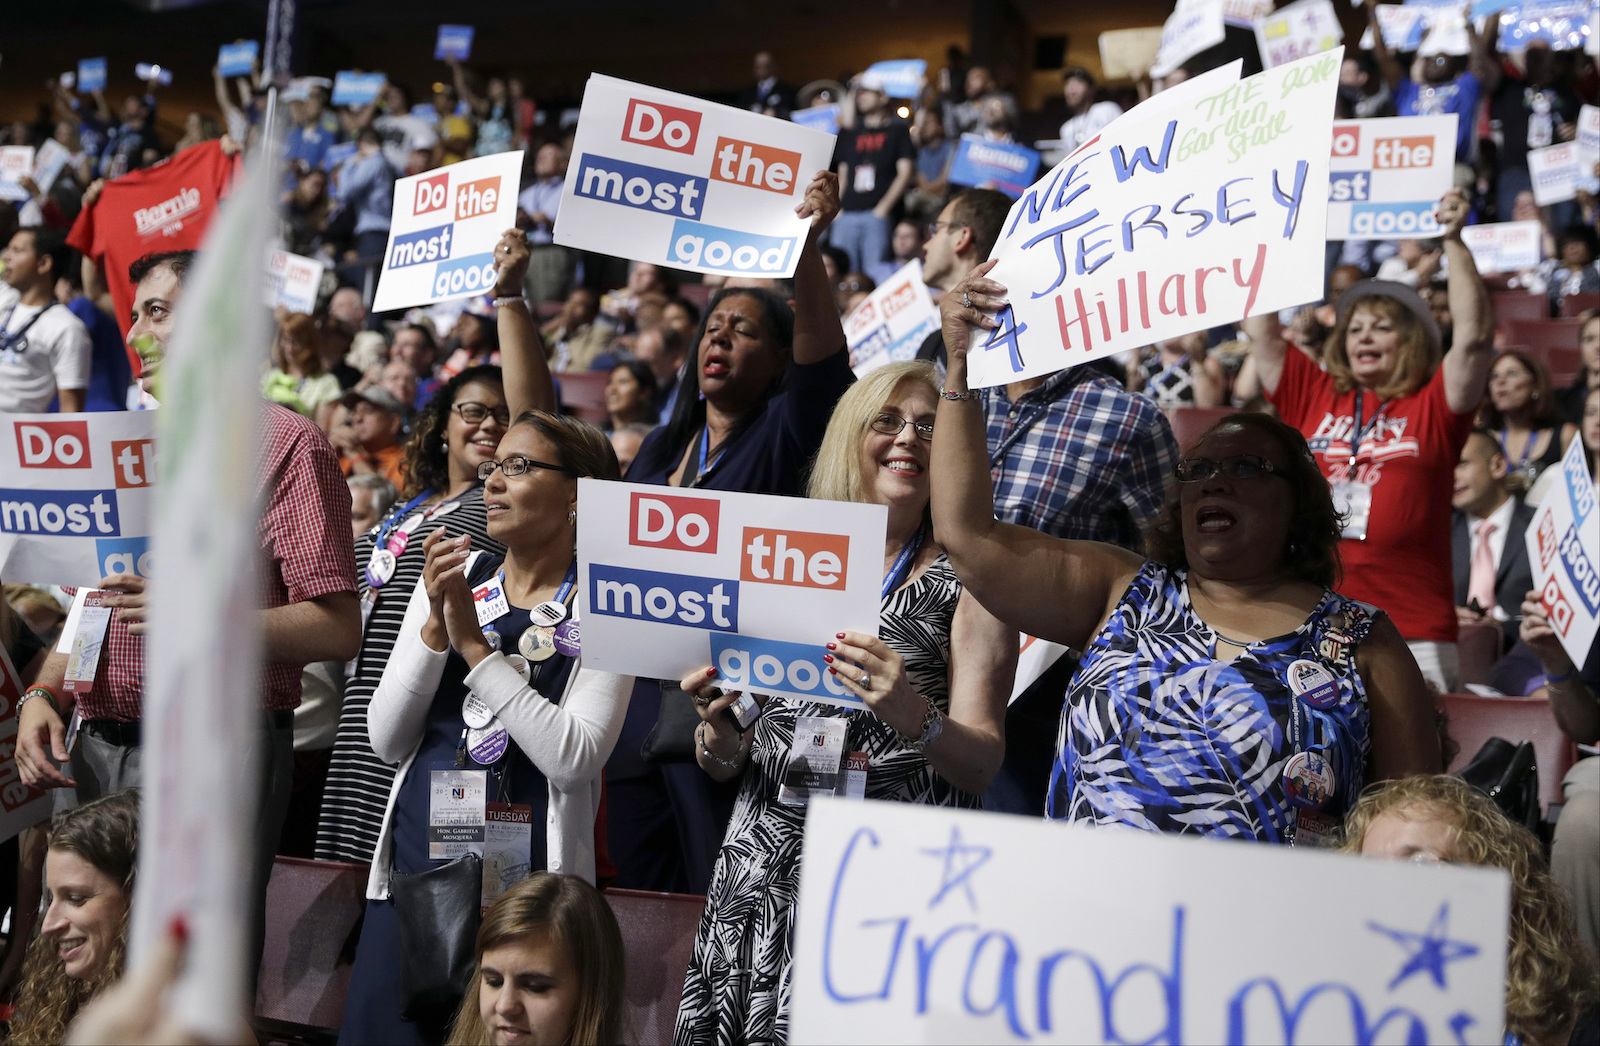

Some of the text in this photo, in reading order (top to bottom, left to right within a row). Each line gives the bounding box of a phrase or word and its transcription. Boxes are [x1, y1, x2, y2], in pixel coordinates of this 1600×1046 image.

[1195, 73, 1266, 122] THE
[628, 103, 793, 190] Do the
[1176, 101, 1268, 162] Garden
[1227, 110, 1294, 164] State
[1333, 133, 1432, 168] o the
[416, 181, 497, 218] Do the
[581, 166, 700, 216] most
[1006, 119, 1178, 240] NEW
[133, 187, 200, 230] Bernie
[1021, 159, 1310, 299] JERSEY
[391, 226, 450, 267] most
[674, 234, 792, 272] good
[979, 244, 1268, 373] 4 Hillary
[20, 425, 160, 485] Do th
[1, 493, 114, 533] most
[637, 497, 710, 548] Do
[746, 534, 842, 586] the
[86, 597, 101, 606] TUES
[479, 600, 505, 617] LATINO
[480, 606, 506, 623] VICTORY
[596, 579, 732, 628] most
[541, 639, 553, 649] NRA
[813, 735, 825, 746] NJ
[452, 788, 465, 800] NJ
[488, 810, 530, 822] TUESDAY
[1300, 816, 1330, 835] TUESDA
